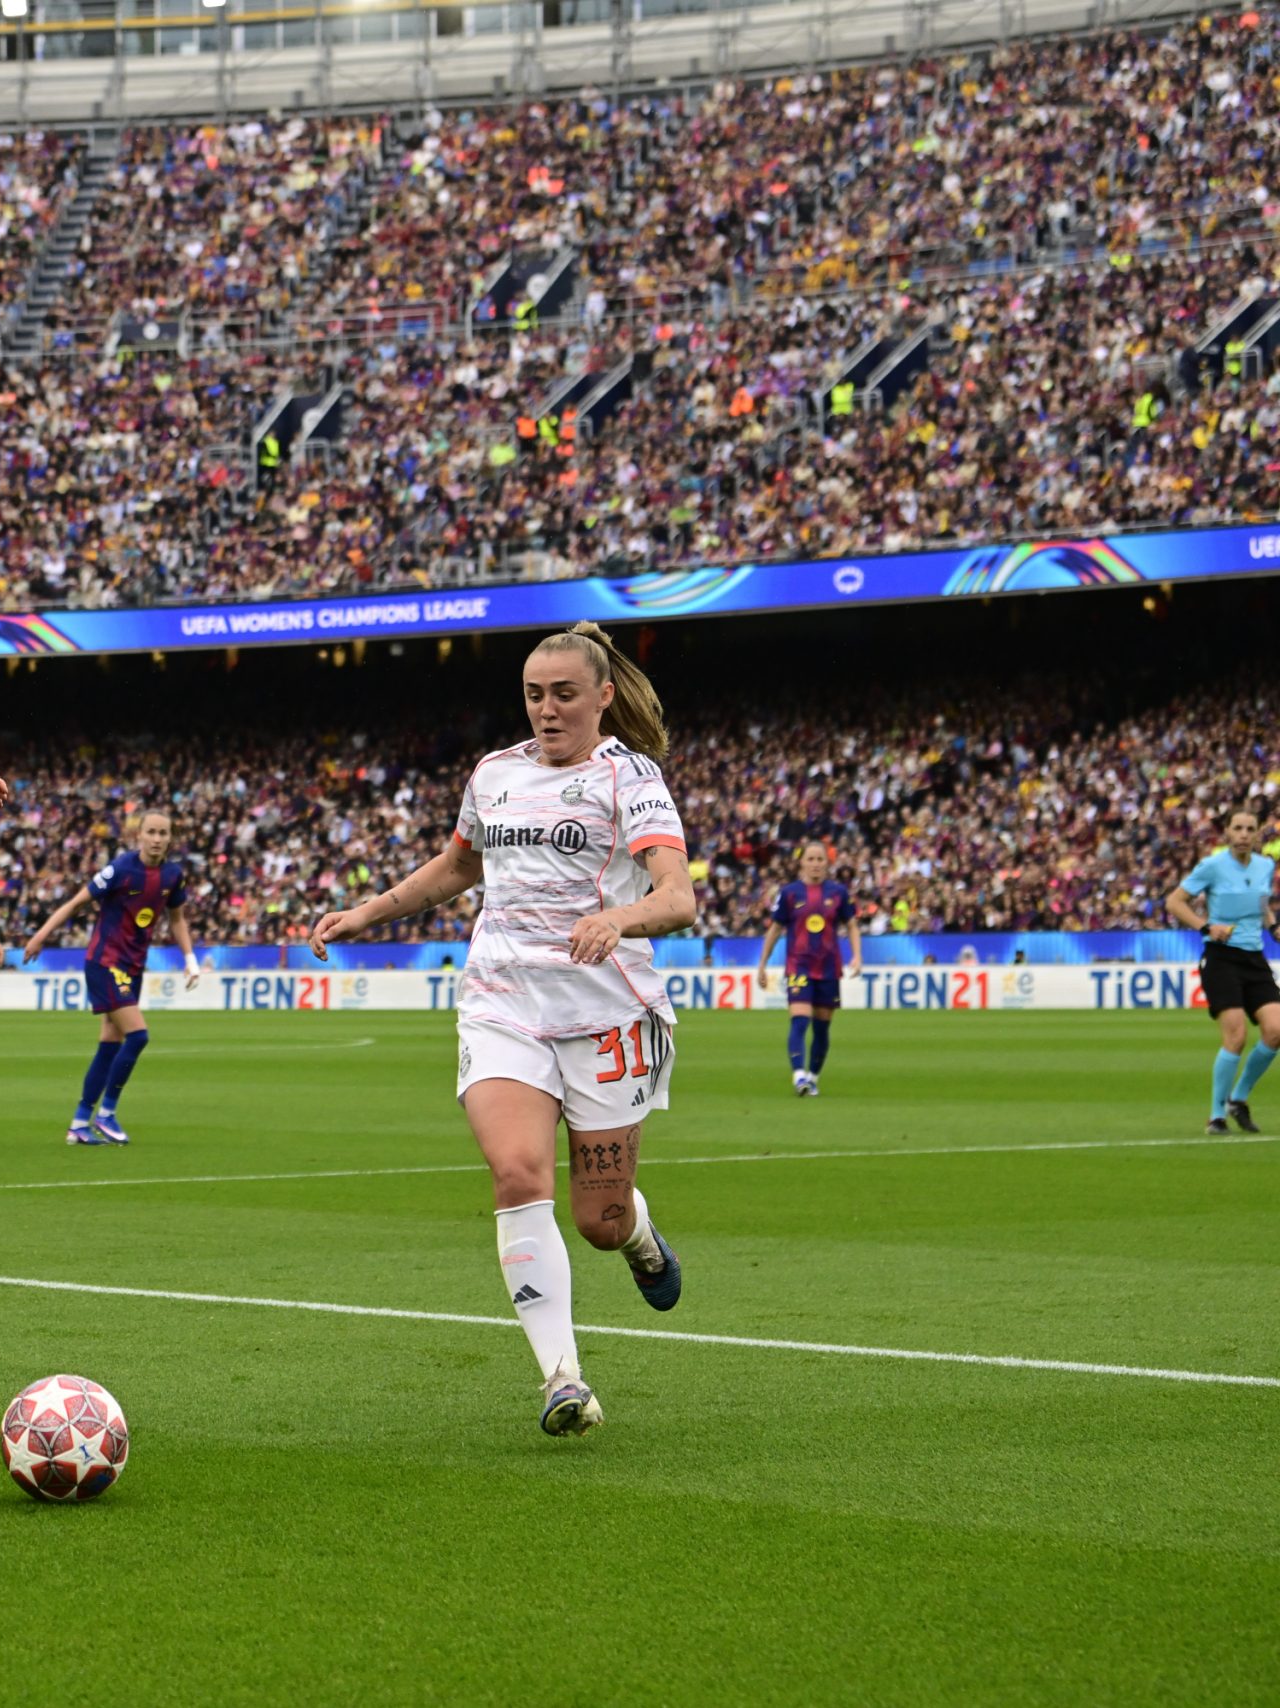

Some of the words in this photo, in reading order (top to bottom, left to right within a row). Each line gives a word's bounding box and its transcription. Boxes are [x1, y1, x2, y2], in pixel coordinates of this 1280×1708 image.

[181, 615, 228, 636] UEFA
[317, 603, 420, 629] CHAMPIONS
[423, 598, 489, 622] LEAGUE
[629, 800, 675, 816] HITAC
[591, 1020, 649, 1084] 31
